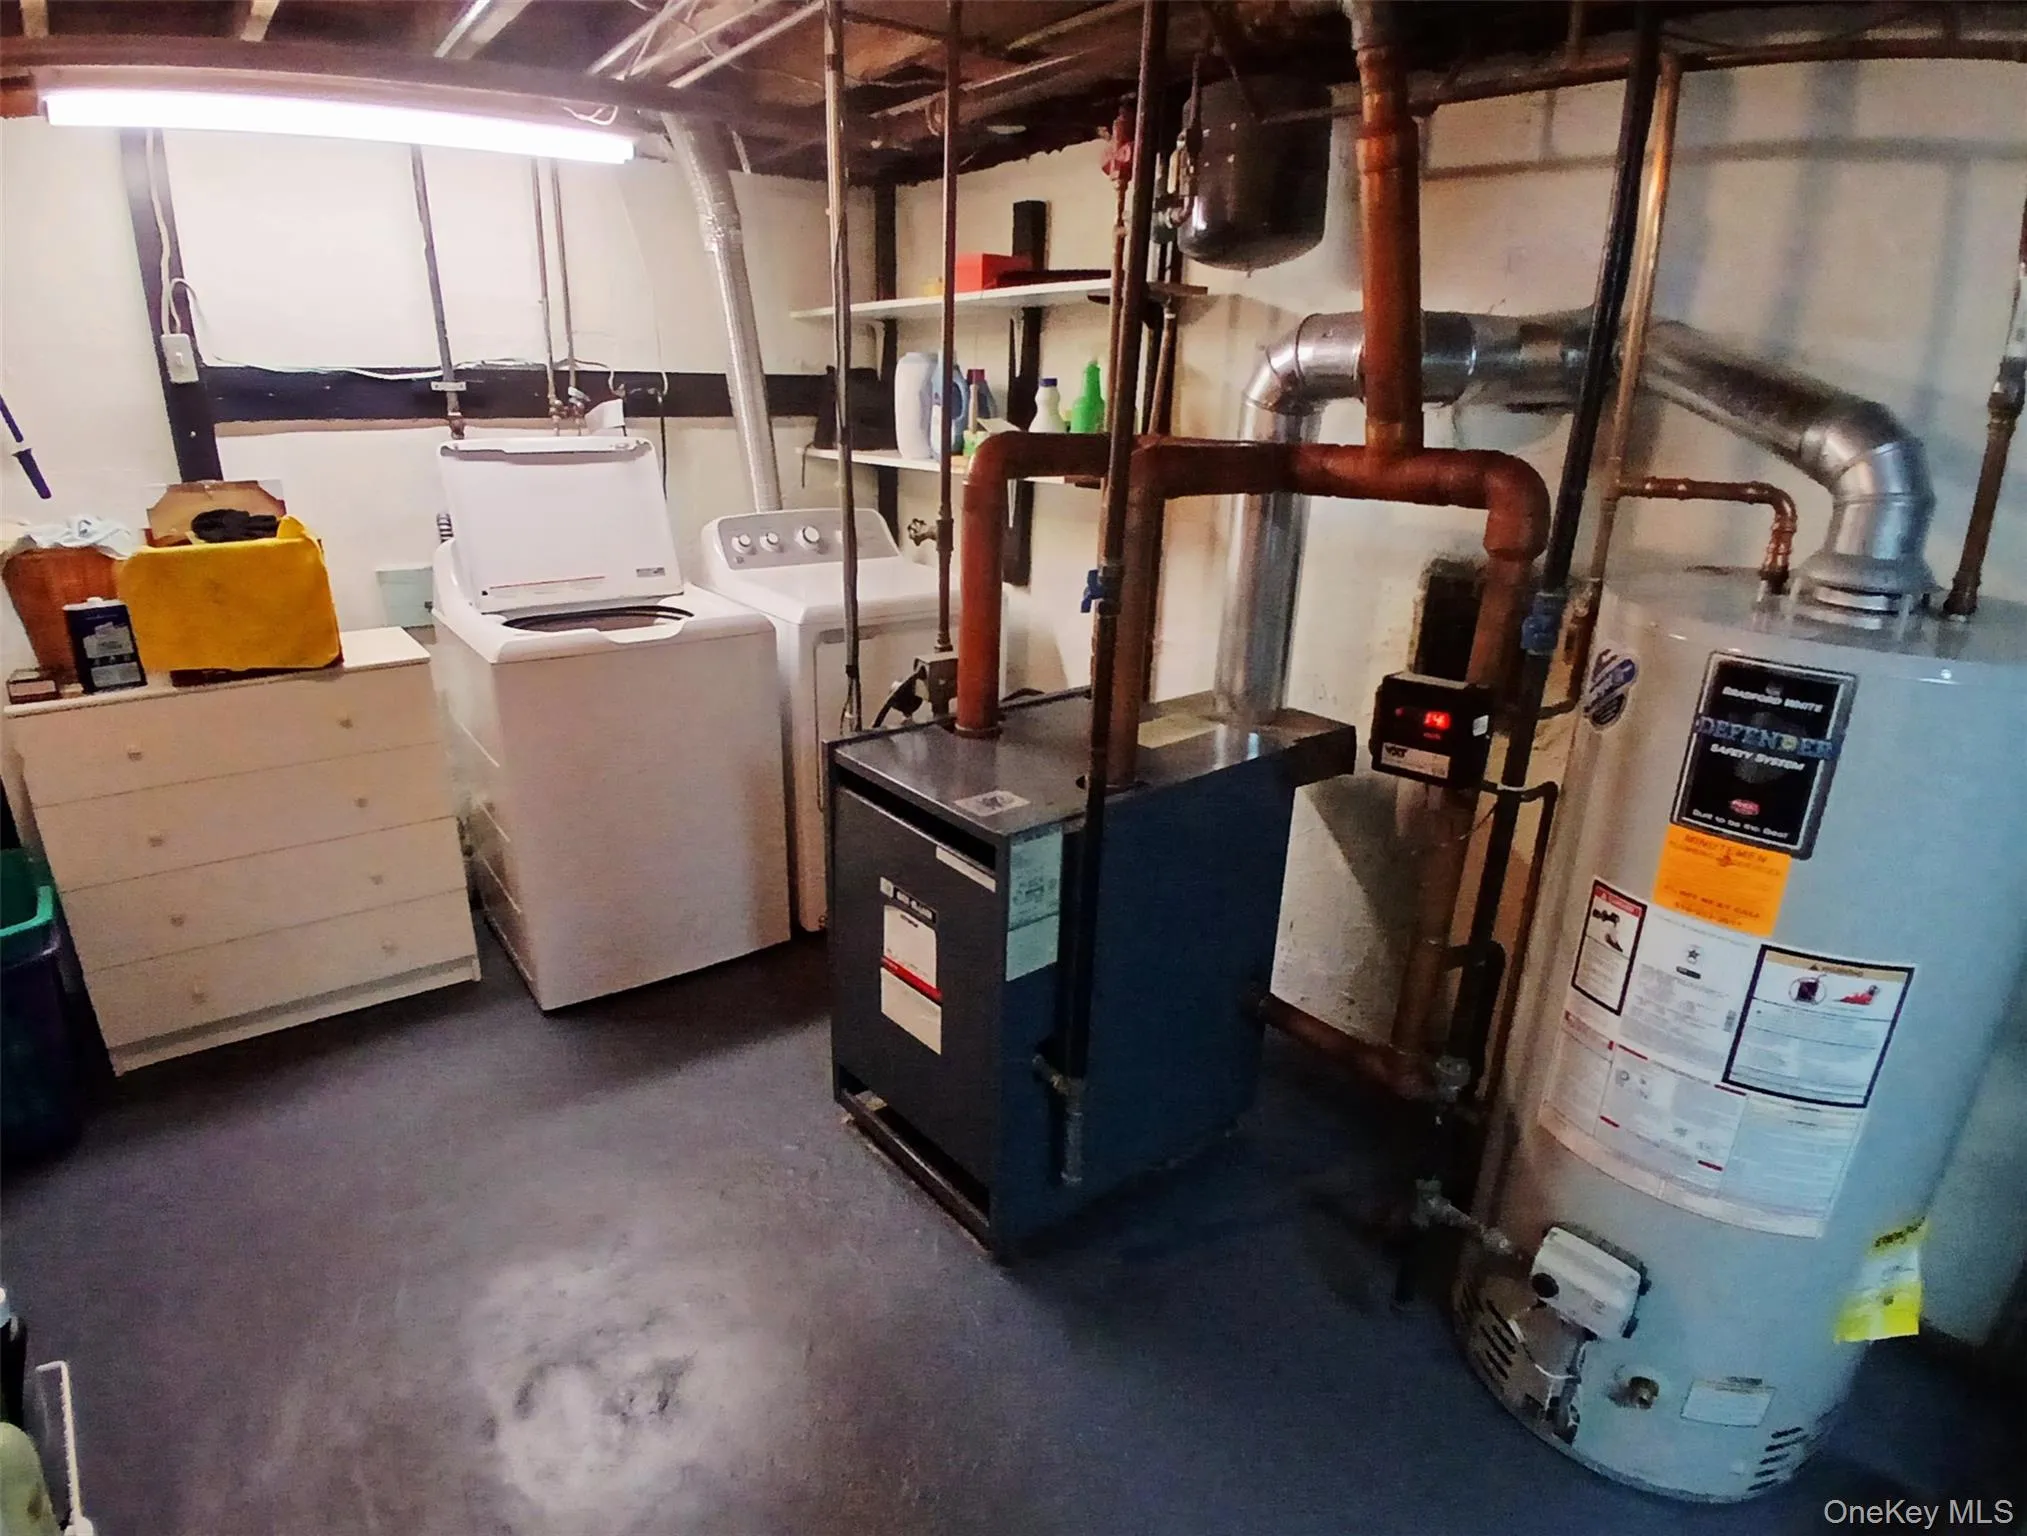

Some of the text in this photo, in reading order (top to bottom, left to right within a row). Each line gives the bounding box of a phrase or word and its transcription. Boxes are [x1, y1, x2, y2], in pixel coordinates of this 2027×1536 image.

[1697, 715, 1834, 761] DEFENDER
[1710, 743, 1806, 772] SAFETY SYSTEM
